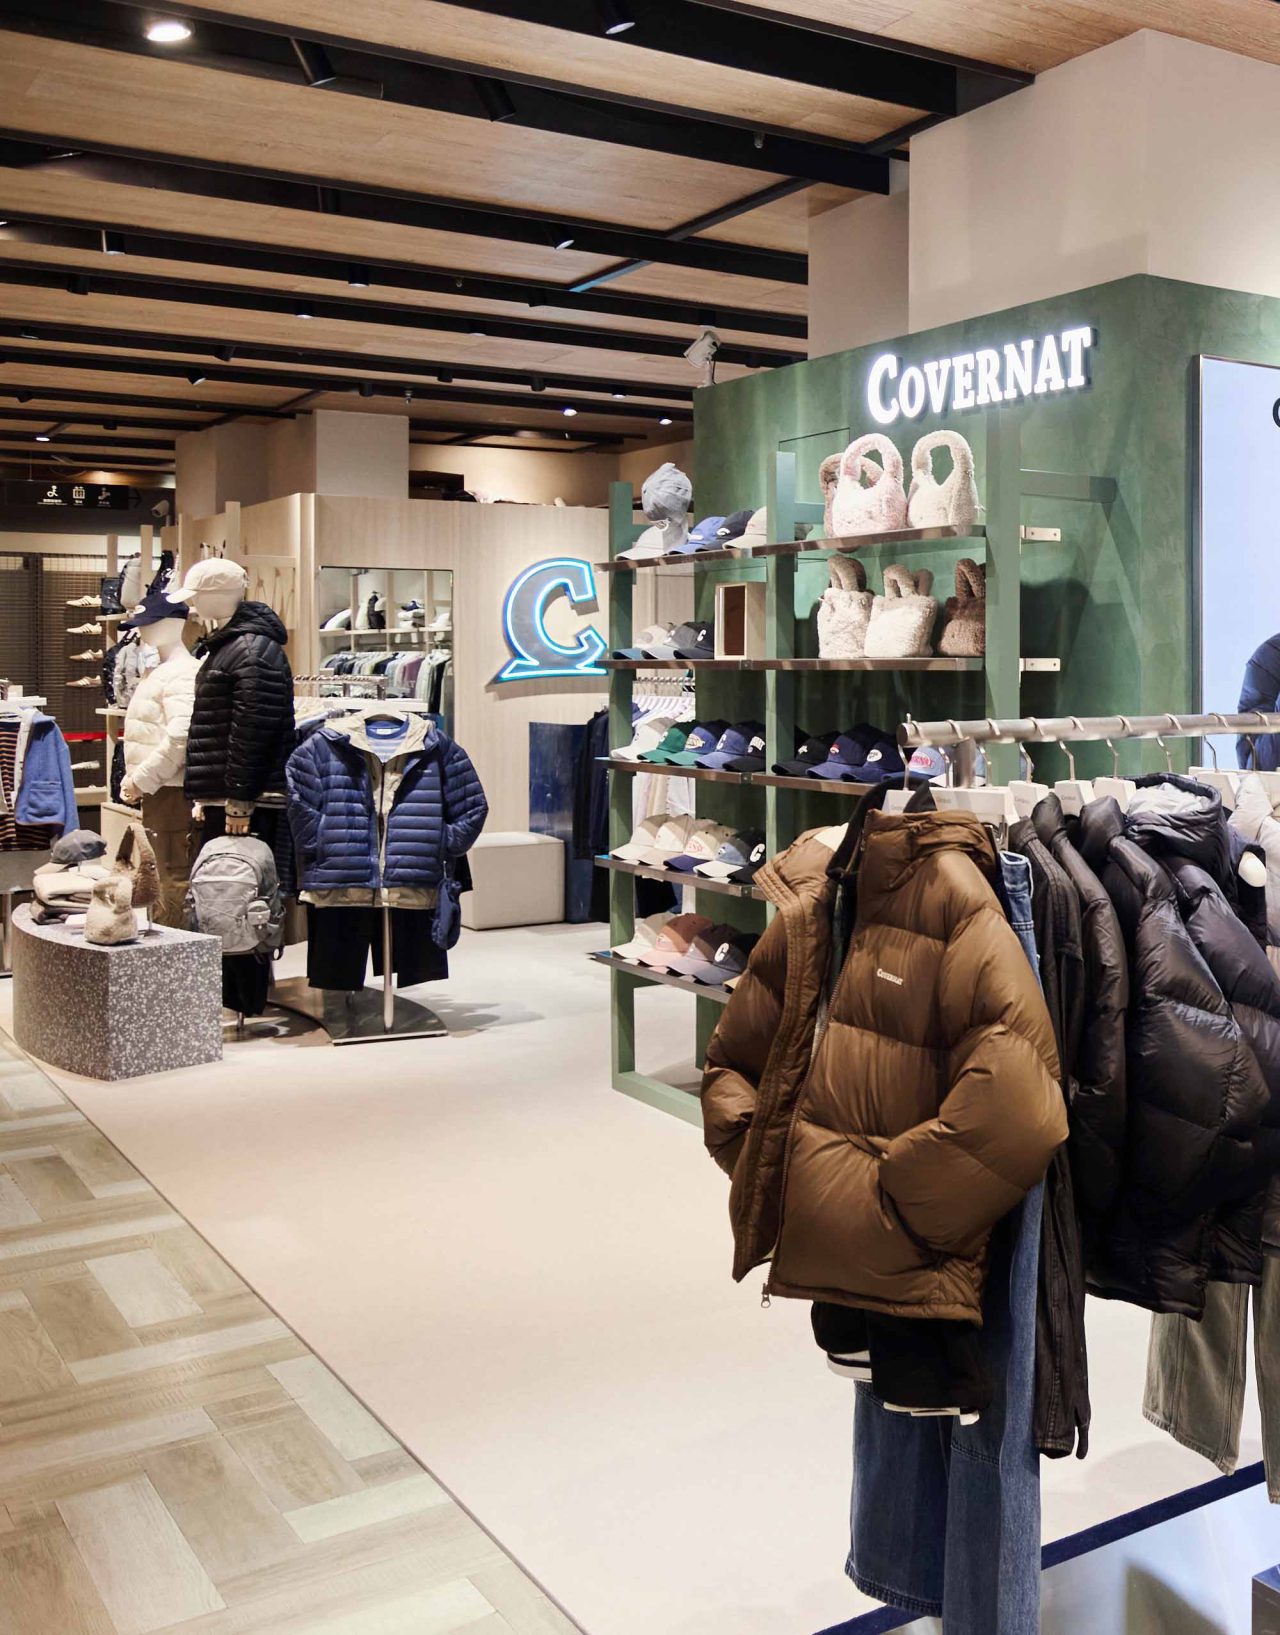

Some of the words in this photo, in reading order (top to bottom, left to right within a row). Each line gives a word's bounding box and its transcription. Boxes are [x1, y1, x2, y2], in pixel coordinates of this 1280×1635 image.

[867, 326, 1092, 424] COVERNAT
[500, 557, 608, 682] C
[749, 843, 766, 862] C
